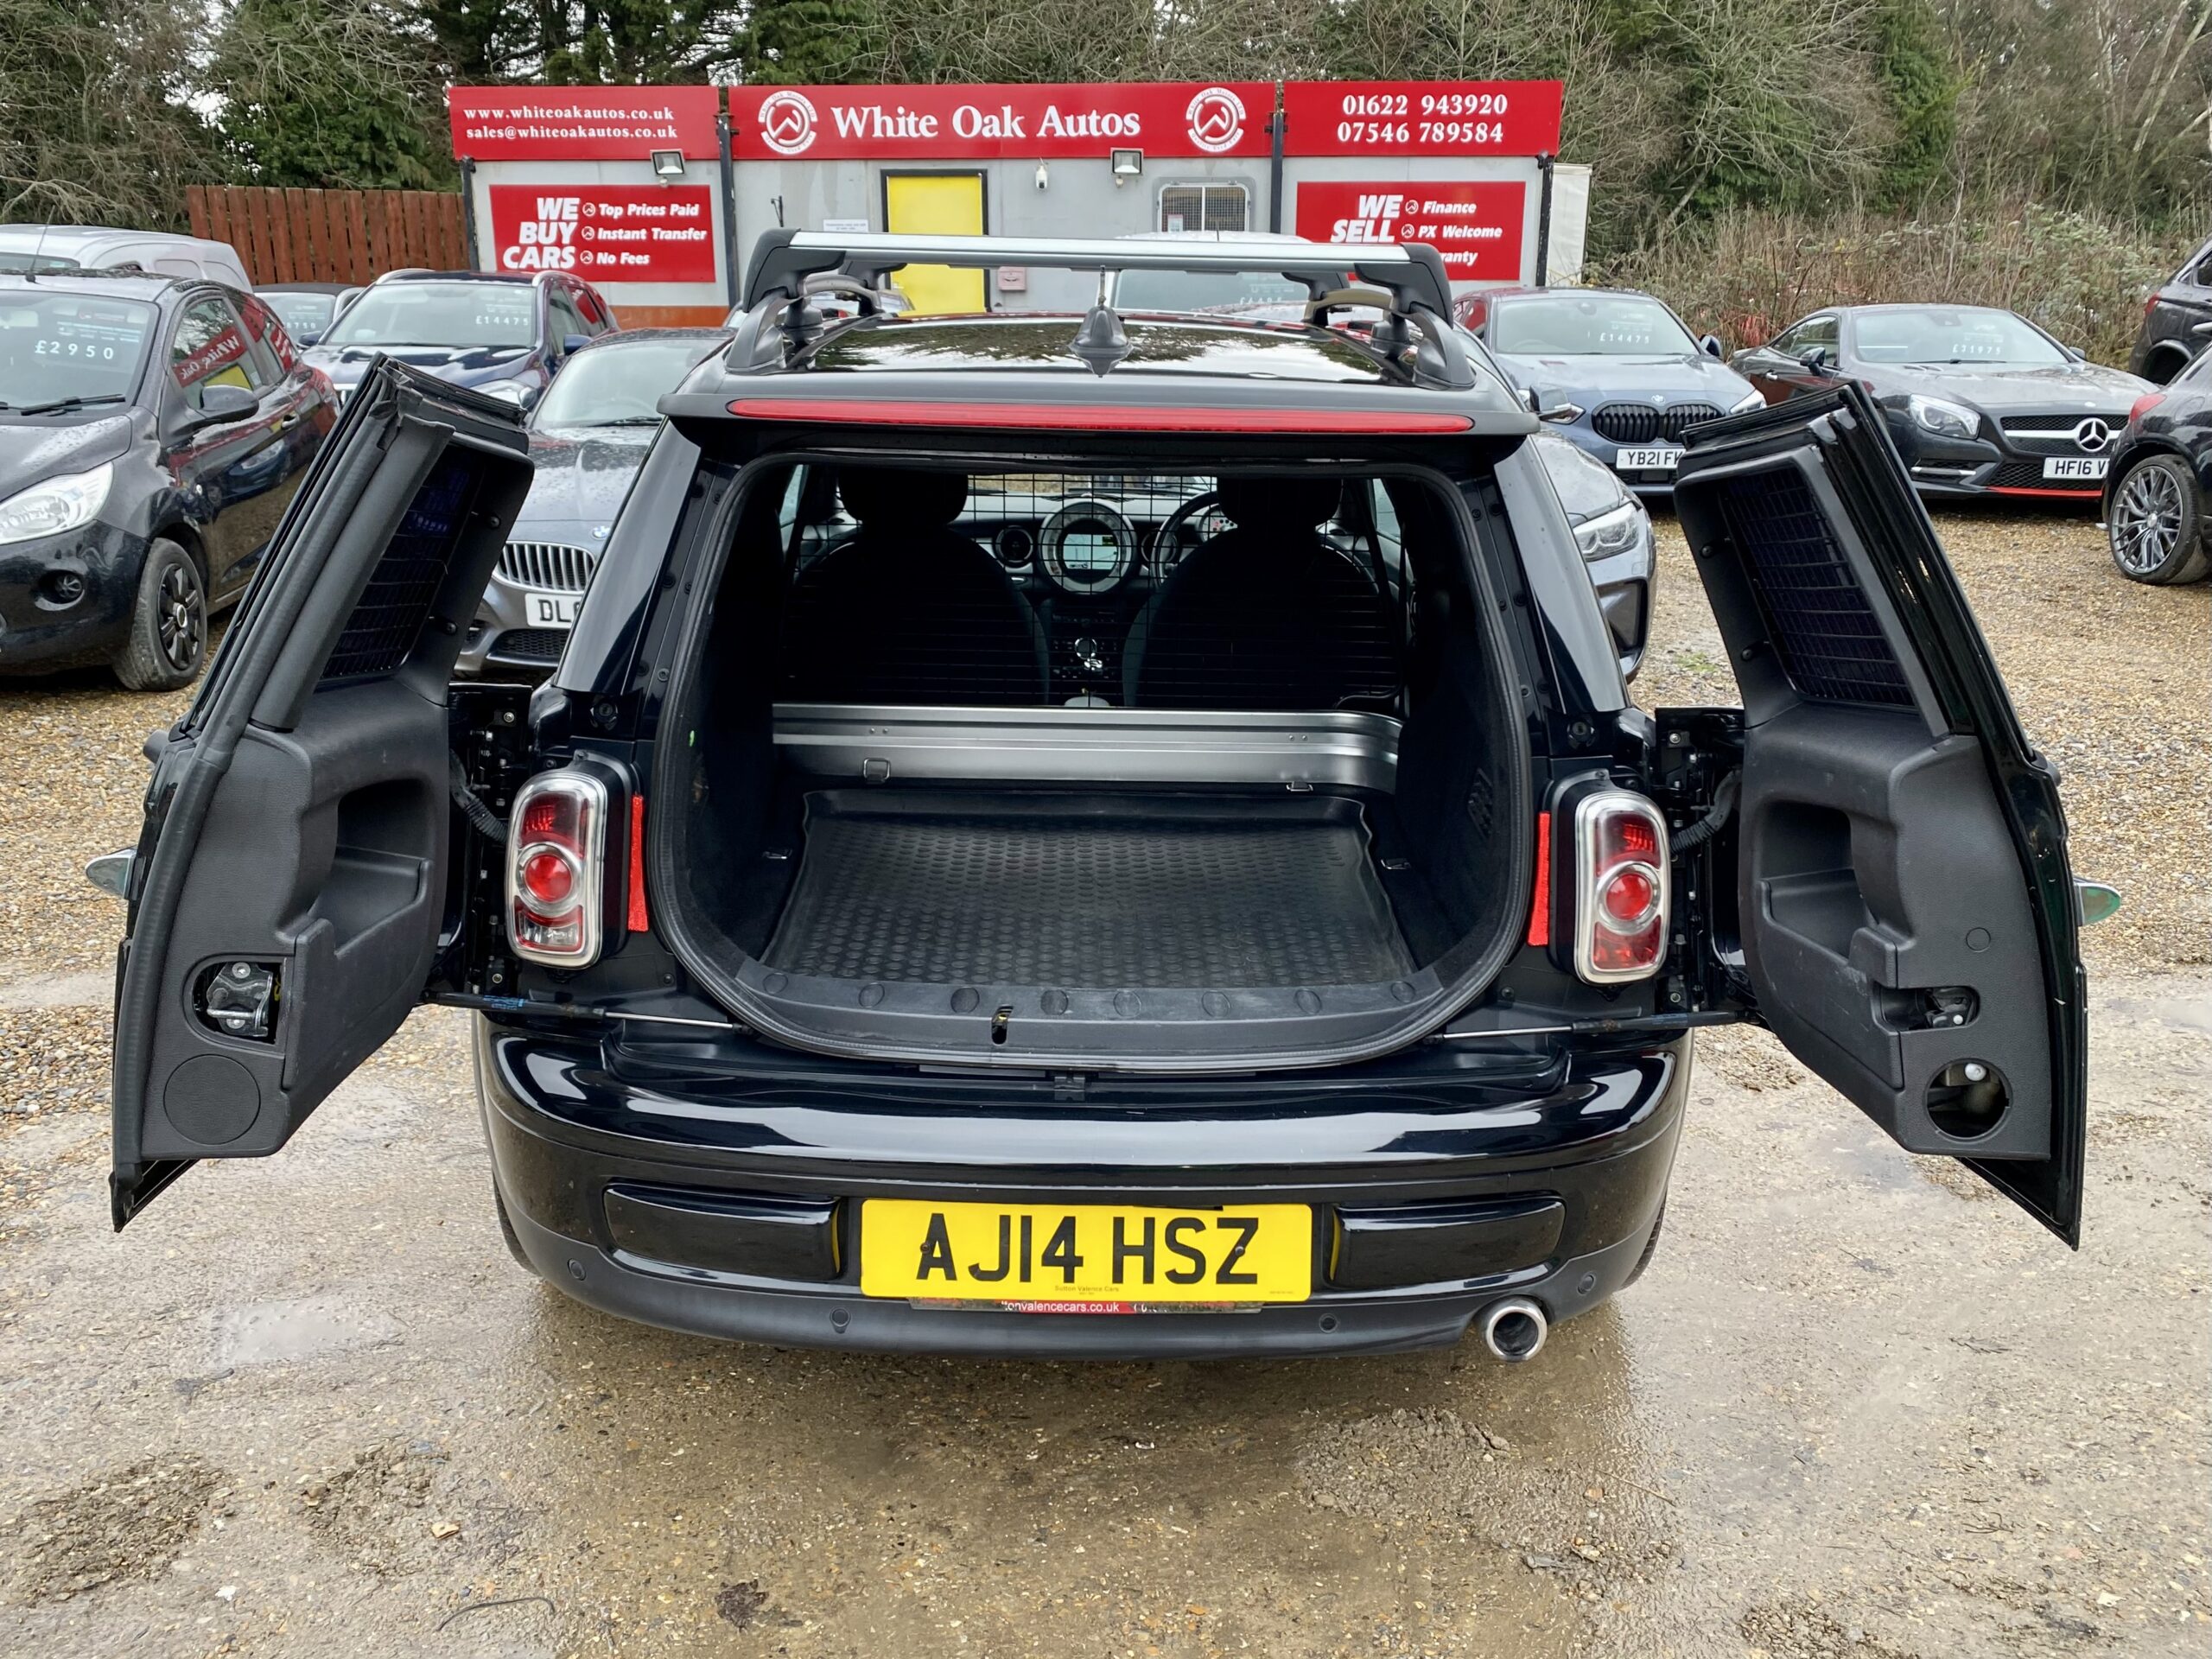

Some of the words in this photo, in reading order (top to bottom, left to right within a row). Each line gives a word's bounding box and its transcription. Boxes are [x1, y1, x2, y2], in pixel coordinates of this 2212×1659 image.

[463, 105, 674, 120] www.whiteoakautos.co.uk
[1342, 94, 1408, 115] 01622
[1421, 94, 1508, 116] 943920
[830, 105, 939, 138] White
[951, 105, 1027, 138] Oak
[1036, 105, 1141, 137] Autos
[466, 125, 678, 139] sales@whiteoakautos.co.uk
[1338, 122, 1410, 143] 07546
[1419, 122, 1504, 143] 789584
[537, 197, 581, 220] WE
[599, 203, 624, 219] Top
[626, 203, 666, 216] Prices
[669, 203, 699, 216] Paid
[1358, 194, 1404, 219] WE
[1422, 200, 1478, 214] Finance
[519, 221, 578, 245] BUY
[597, 227, 647, 240] Instant
[652, 227, 708, 240] Transfer
[1330, 219, 1395, 243] SELL
[1417, 225, 1438, 238] PX
[1442, 225, 1503, 238] Welcome
[502, 245, 576, 269] CARS
[596, 251, 615, 264] No
[620, 251, 650, 264] Fees
[1440, 250, 1479, 266] ranty
[475, 315, 529, 326] £14475
[35, 340, 114, 360] £2950
[1627, 451, 1661, 466] YB21
[2054, 460, 2093, 475] HF16
[916, 1212, 1084, 1284] AJ14
[1112, 1216, 1260, 1286] HSZ
